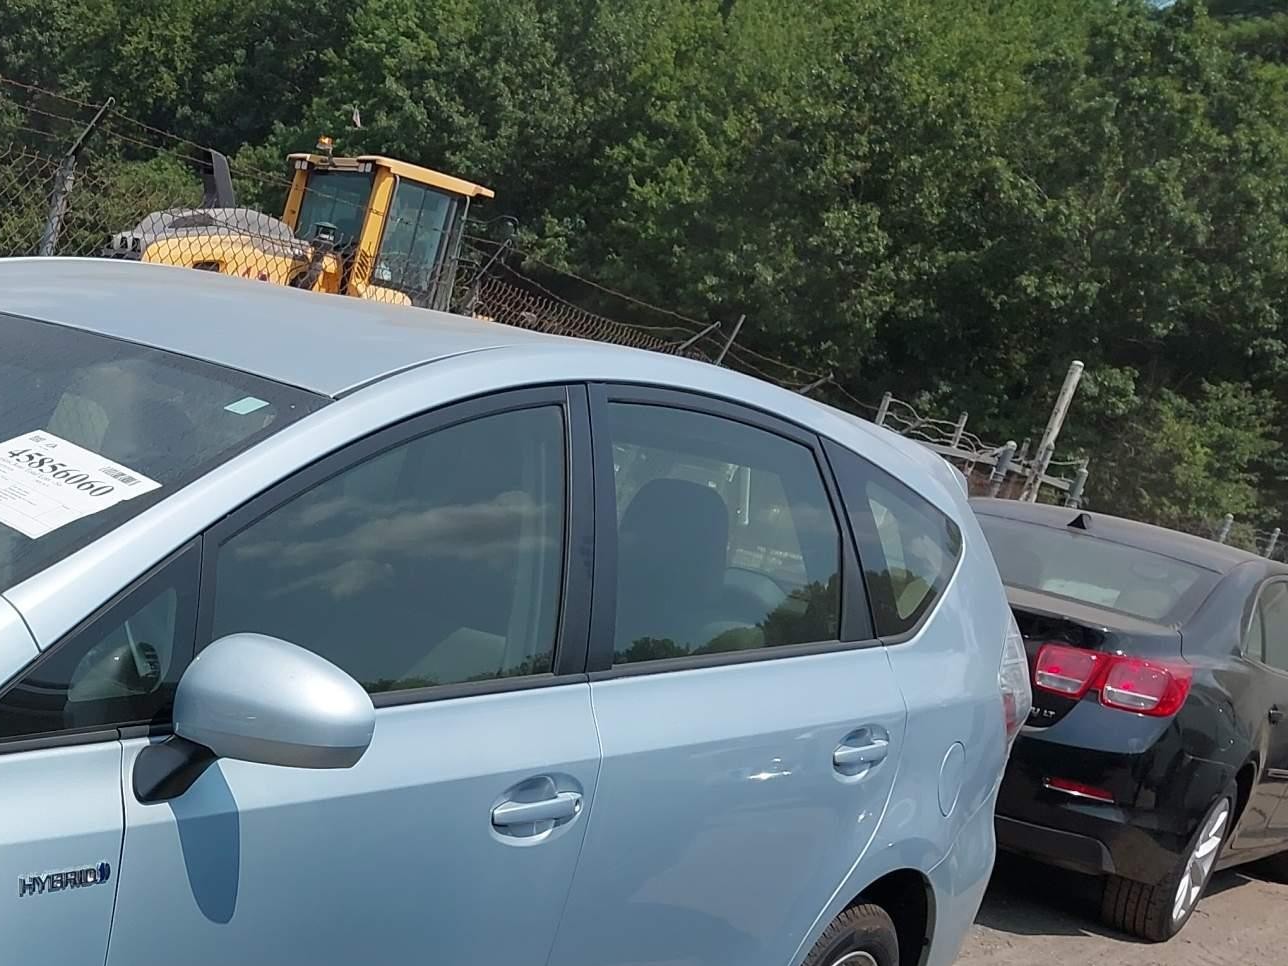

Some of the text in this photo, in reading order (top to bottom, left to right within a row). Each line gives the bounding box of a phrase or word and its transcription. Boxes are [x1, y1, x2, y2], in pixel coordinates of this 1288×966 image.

[8, 448, 114, 497] 45856060
[1043, 709, 1056, 718] LT
[18, 867, 98, 898] HYBRID
